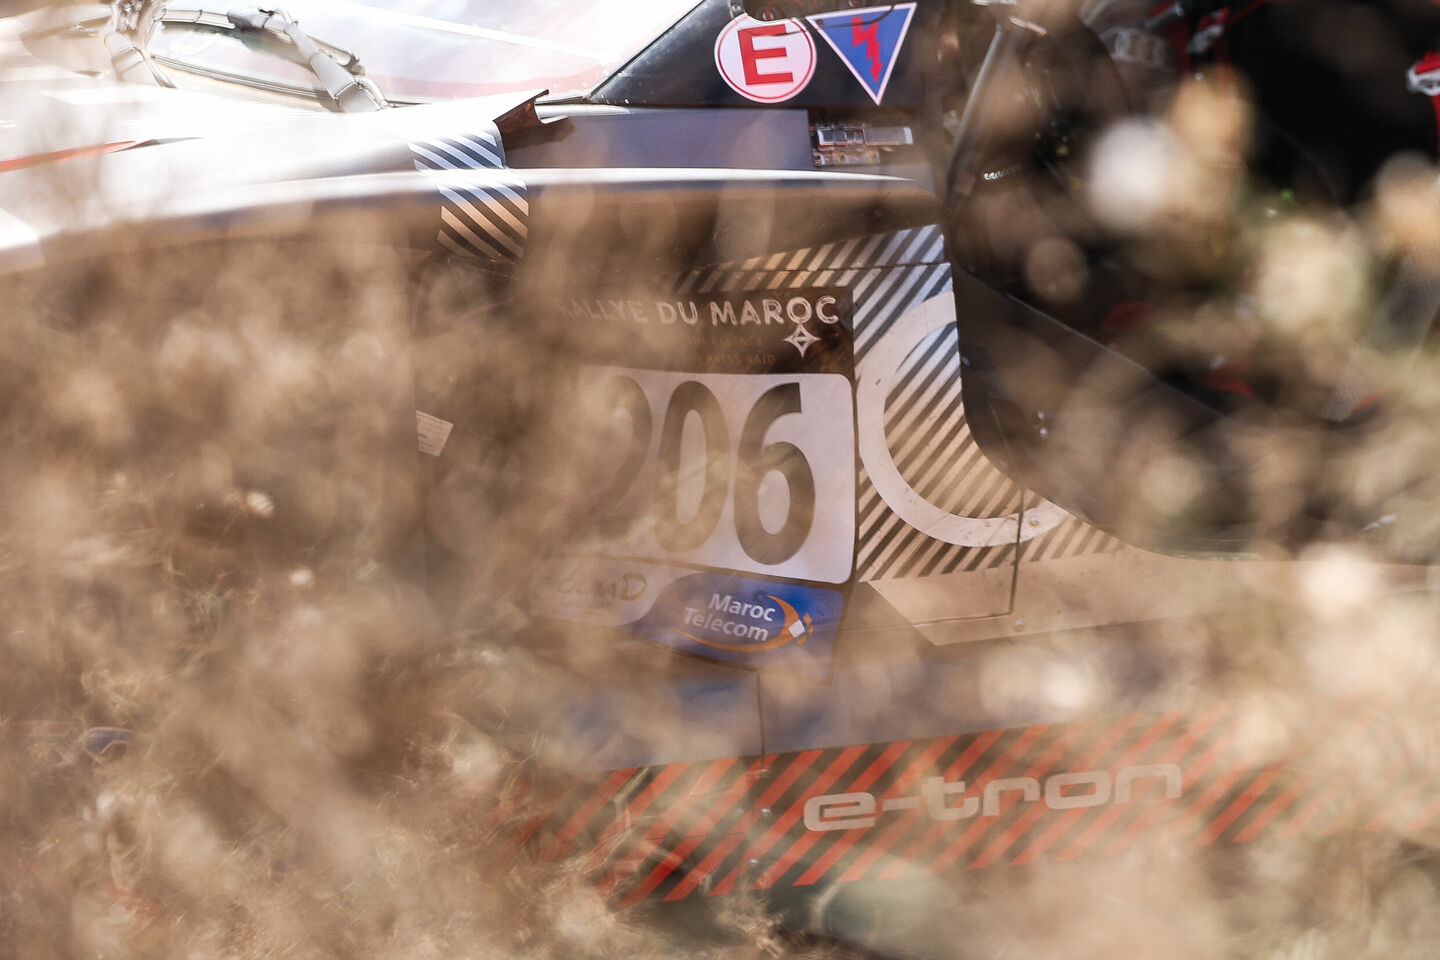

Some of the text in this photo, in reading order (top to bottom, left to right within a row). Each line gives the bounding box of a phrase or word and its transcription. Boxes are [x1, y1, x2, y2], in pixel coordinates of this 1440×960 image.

[738, 24, 794, 86] E
[659, 301, 699, 325] DU
[710, 295, 840, 327] MAROC
[683, 607, 769, 641] Telecom
[708, 592, 777, 622] Maroc
[803, 763, 1183, 832] e-tron
